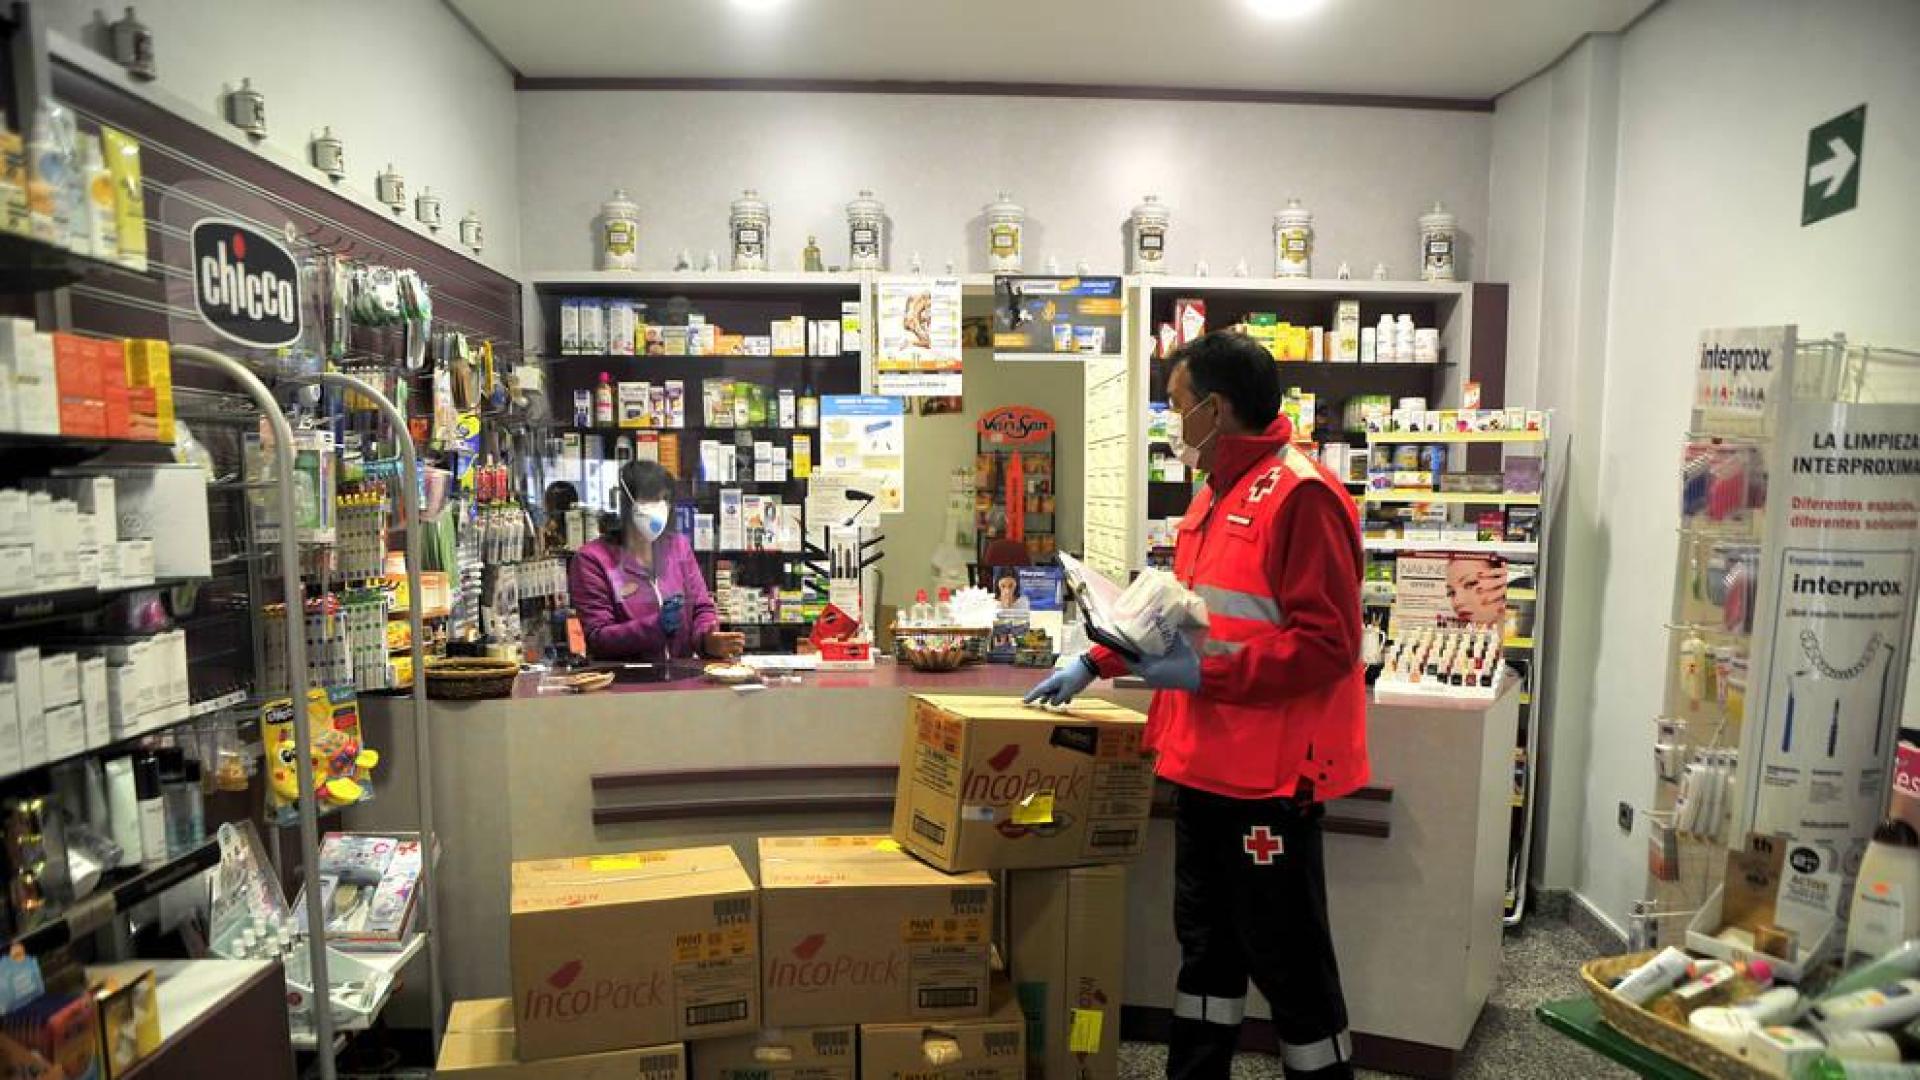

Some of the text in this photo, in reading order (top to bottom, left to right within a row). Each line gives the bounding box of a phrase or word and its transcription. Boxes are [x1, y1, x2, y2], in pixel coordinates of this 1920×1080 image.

[201, 230, 294, 323] chicco
[1700, 342, 1773, 377] interprox
[1813, 431, 1836, 450] LA
[1791, 496, 1863, 511] Diferentes
[1790, 515, 1861, 530] diferentes
[1793, 573, 1902, 601] interprox
[963, 766, 1083, 803] IncoPack
[769, 952, 900, 991] IncoPack
[524, 970, 666, 1022] IncoPack
